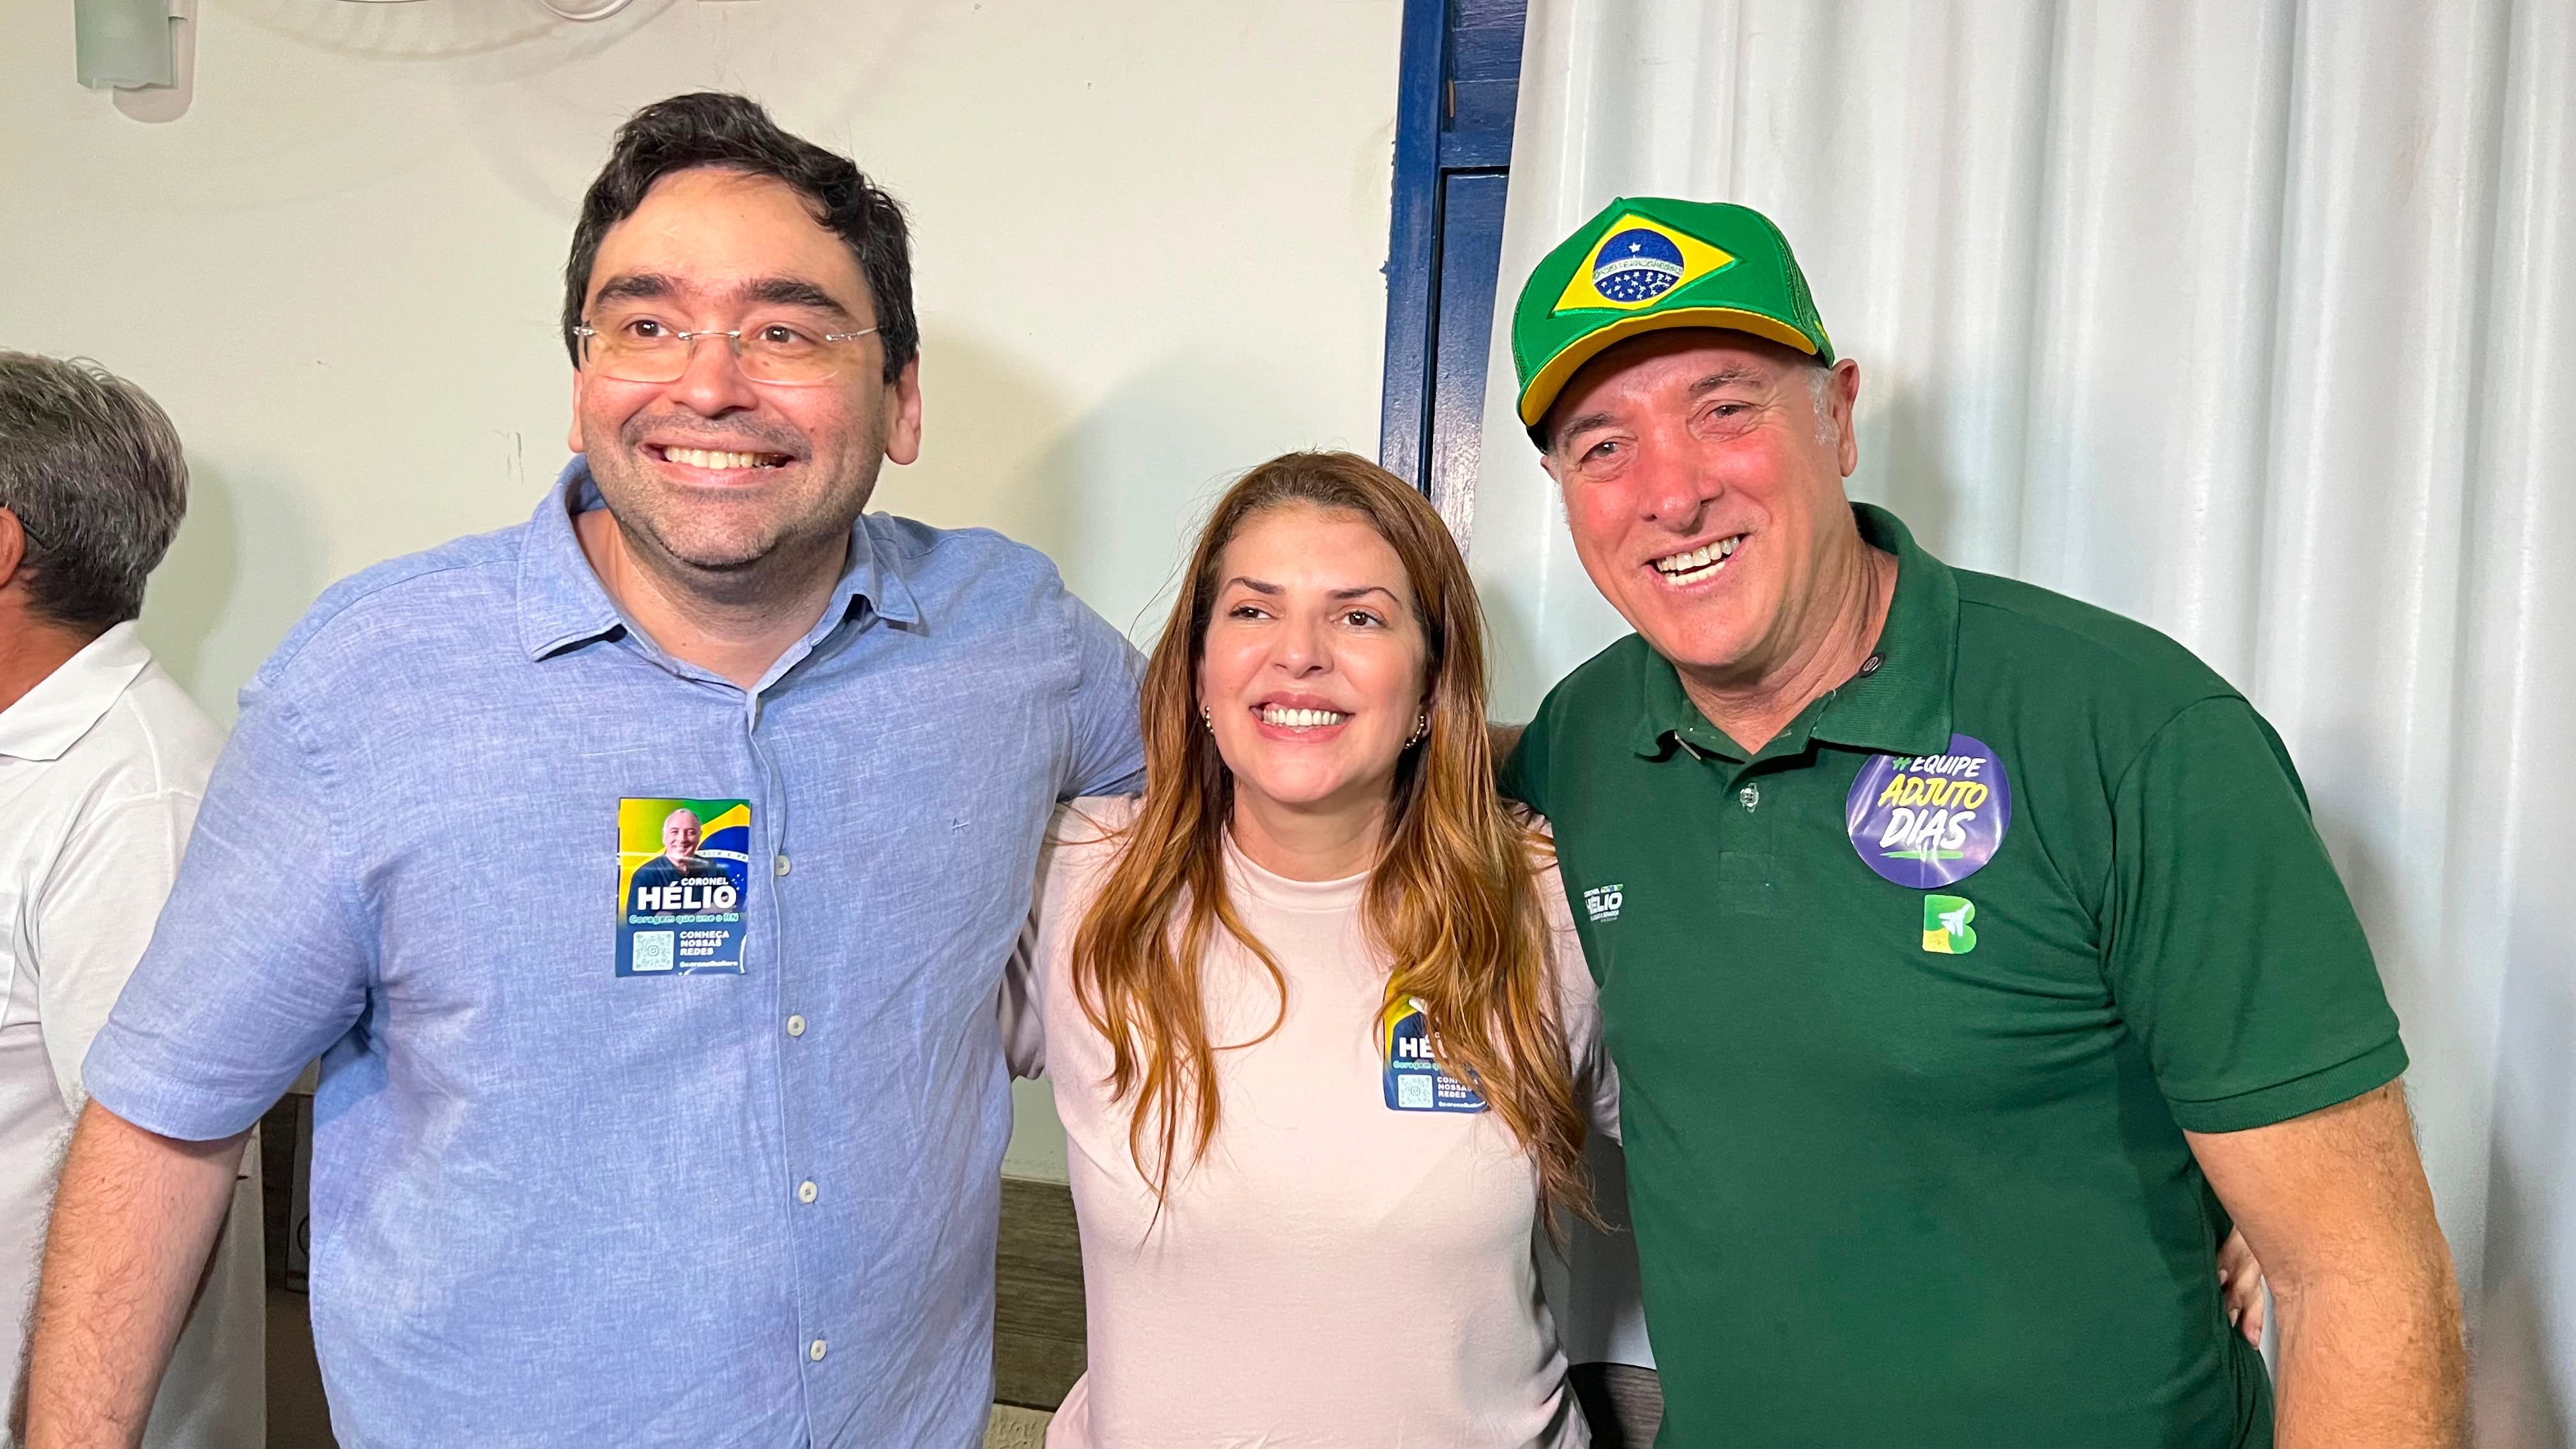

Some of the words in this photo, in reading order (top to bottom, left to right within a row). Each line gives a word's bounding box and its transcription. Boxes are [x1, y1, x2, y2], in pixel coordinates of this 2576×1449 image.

[1892, 755, 1986, 778] #EQUIPE
[1878, 773, 1988, 809] ADJUTO
[1879, 808, 1976, 849] DIAS
[681, 877, 728, 886] CORONEL
[638, 880, 737, 910] HÉLIO
[629, 914, 675, 925] Coragem
[676, 915, 695, 924] que
[723, 912, 739, 922] RN
[680, 930, 730, 939] CONHEÇA
[680, 939, 722, 947] NOSSAS
[680, 947, 714, 956] REDES
